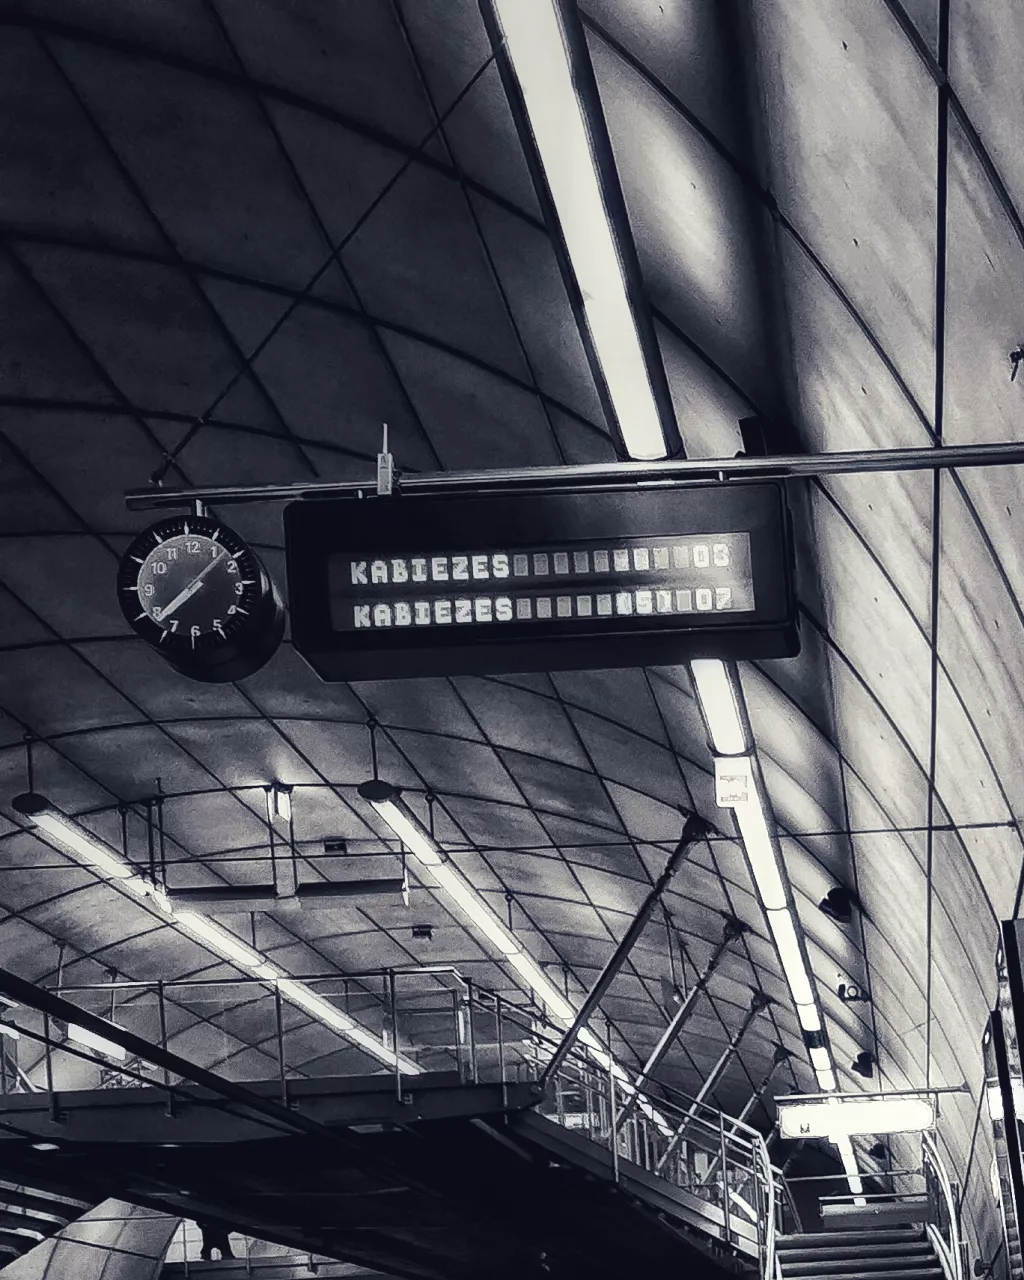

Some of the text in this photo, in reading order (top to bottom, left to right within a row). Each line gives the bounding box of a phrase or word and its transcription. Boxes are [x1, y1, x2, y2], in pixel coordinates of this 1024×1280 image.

[185, 541, 201, 553] 12
[210, 546, 218, 558] 1
[166, 548, 178, 560] 11
[151, 561, 167, 574] 10
[227, 561, 237, 573] 2
[350, 554, 510, 584] KABIEZES
[144, 584, 155, 596] 9
[235, 582, 244, 595] 3
[227, 605, 237, 615] 4
[353, 597, 513, 628] KABIEZES
[169, 620, 179, 633] 7
[190, 625, 201, 637] 6
[213, 619, 222, 631] 5
